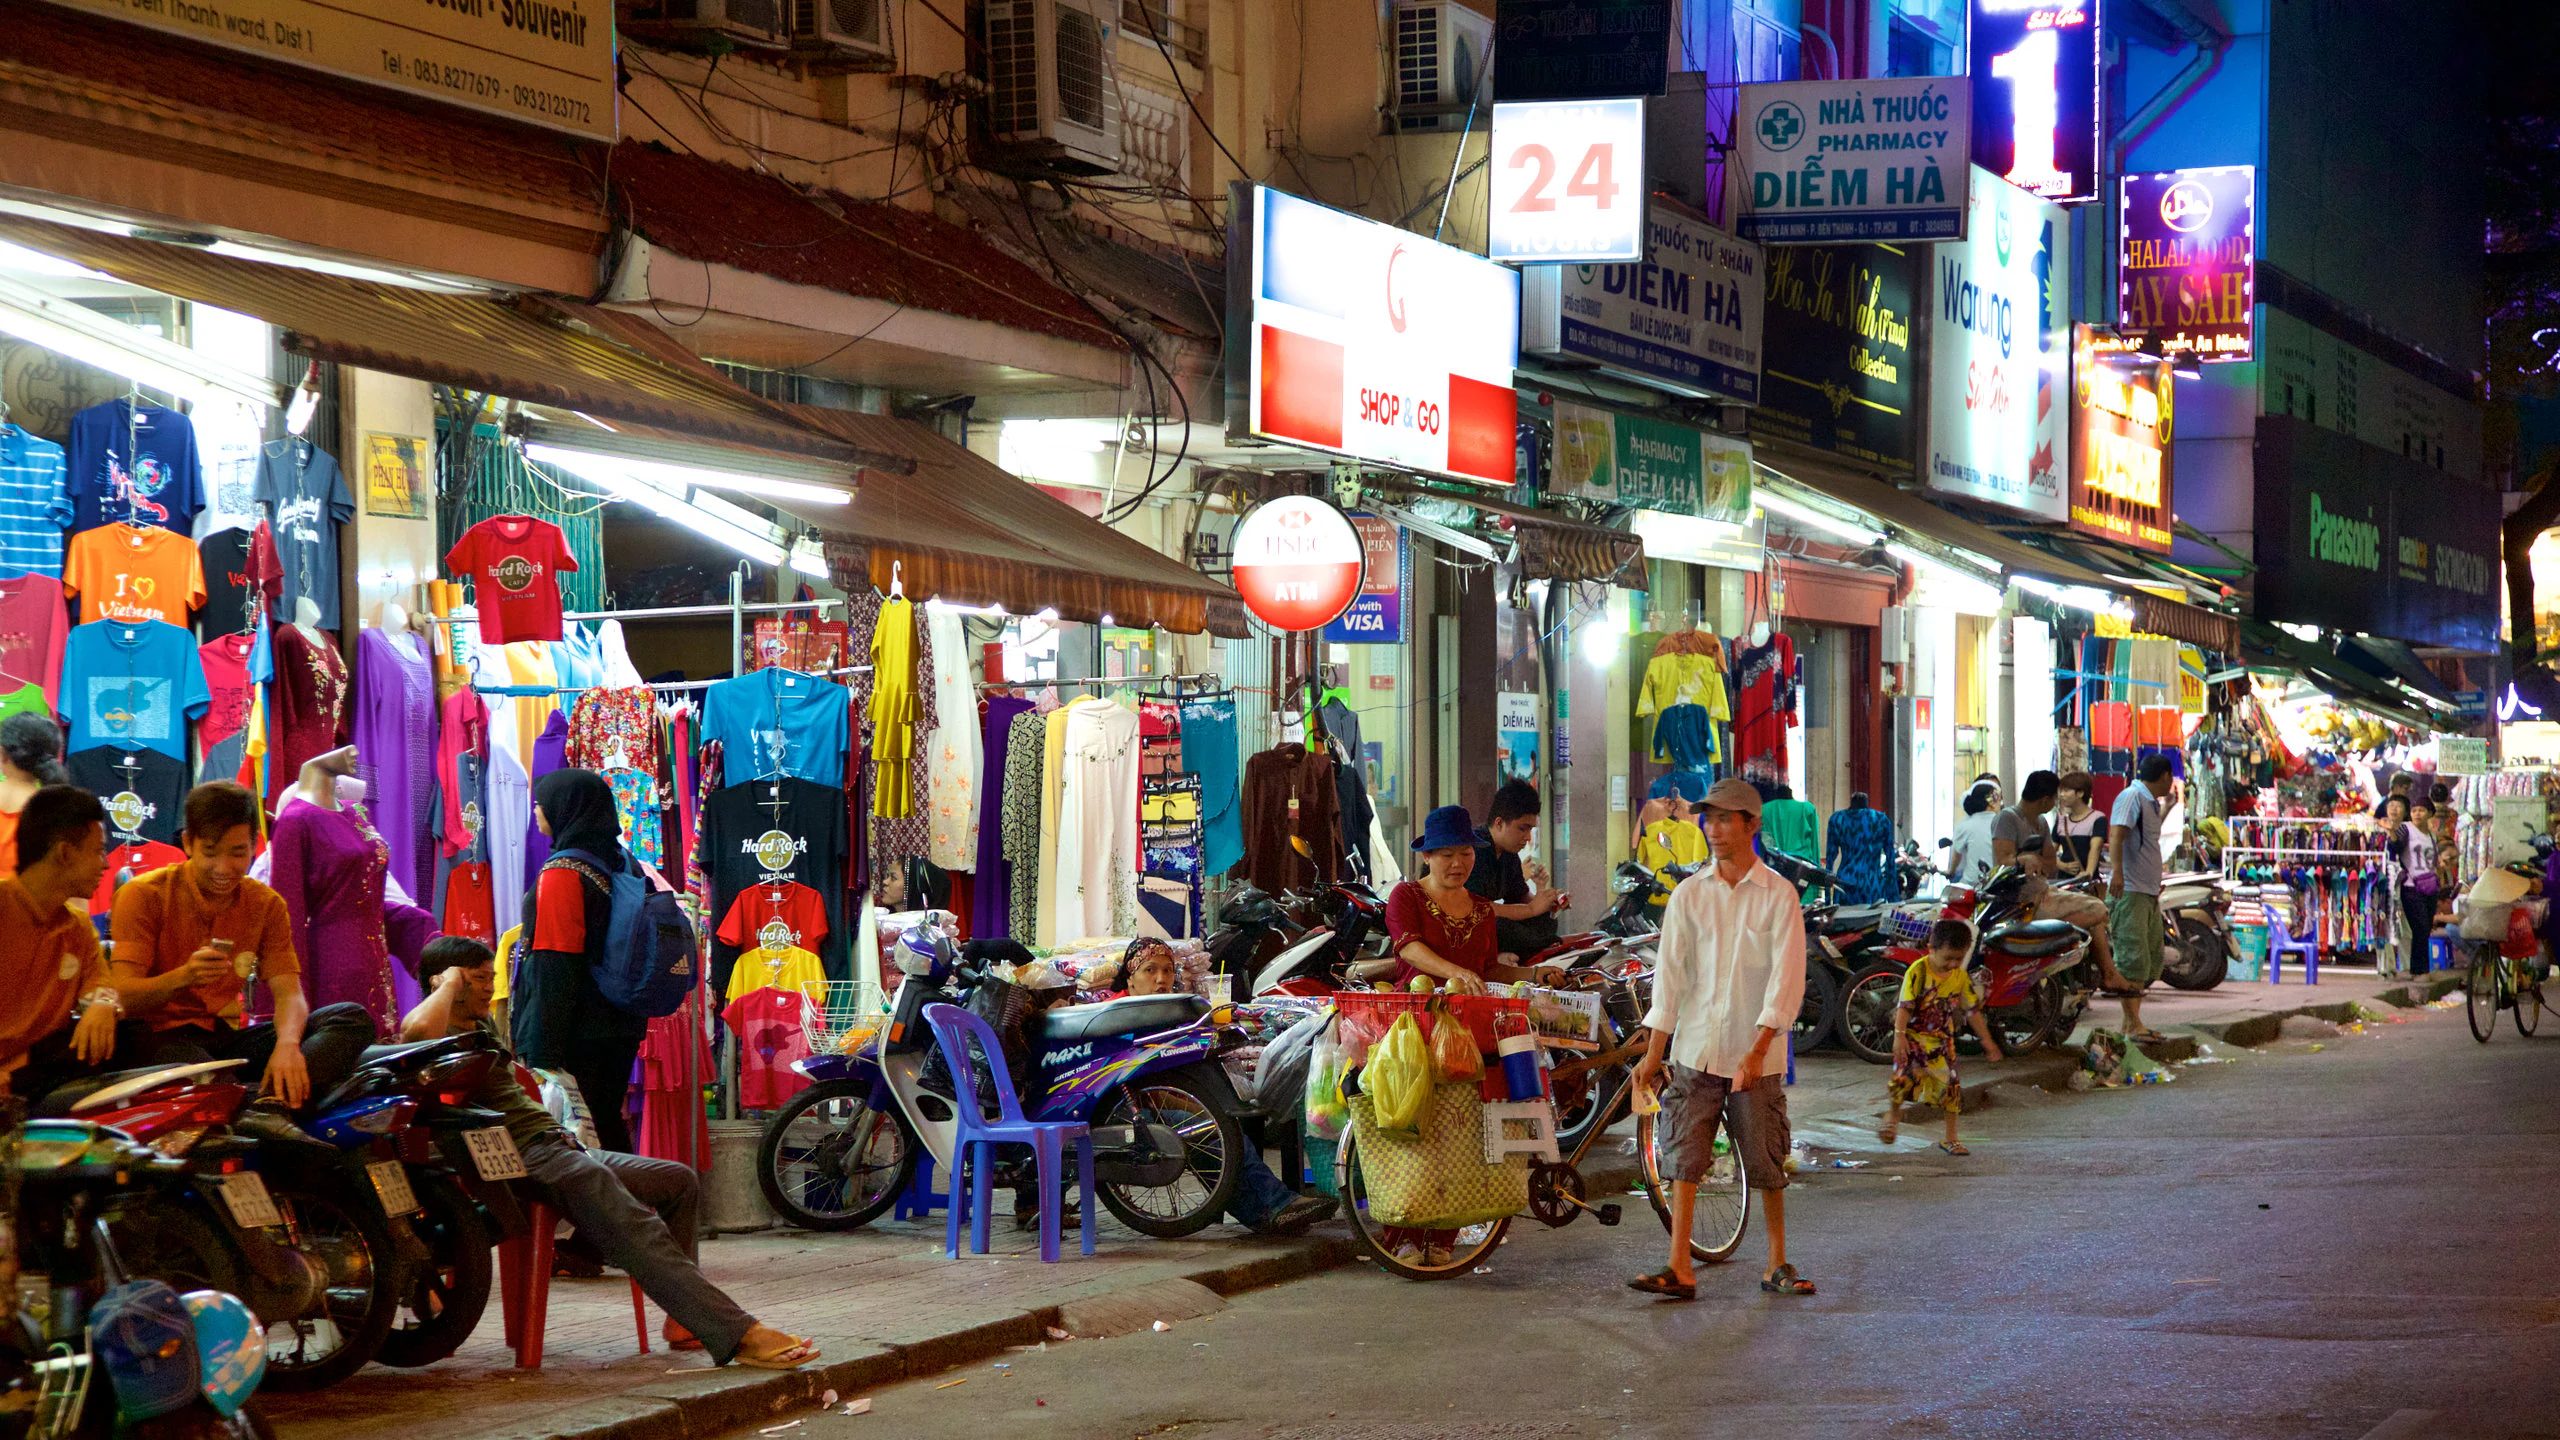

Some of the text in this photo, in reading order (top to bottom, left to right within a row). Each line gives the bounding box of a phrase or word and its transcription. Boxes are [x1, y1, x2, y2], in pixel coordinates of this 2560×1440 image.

[274, 22, 301, 49] Dist
[305, 29, 314, 52] 1
[501, 0, 587, 47] Souvenir
[381, 50, 402, 75] Tel
[413, 58, 500, 99] 083.8277679
[513, 84, 592, 124] 0932123772
[1819, 84, 1949, 127] NHÀ THUỐC
[1818, 130, 1949, 153] PHARMACY
[1507, 142, 1620, 214] 24
[1754, 154, 1868, 209] DIỄM
[1886, 156, 1945, 205] HÀ
[2128, 238, 2191, 269] HALAL
[1705, 275, 1743, 331] HÀ
[1942, 255, 2012, 360] Warung
[2178, 272, 2245, 326] SAH
[2195, 335, 2213, 352] An
[1849, 345, 1898, 385] Collection
[1360, 388, 1439, 435] SHOP & GO
[1630, 434, 1687, 464] PHARMACY
[1620, 459, 1665, 500] DIỄM
[2310, 492, 2380, 572] Panasonic
[515, 561, 543, 577] Rock
[115, 573, 128, 598] I
[1275, 580, 1319, 602] ATM
[98, 601, 166, 621] Vietnam
[1359, 601, 1382, 612] with
[1343, 614, 1384, 631] VISA
[1525, 713, 1535, 728] HÀ
[741, 836, 807, 854] Hard Rock
[758, 873, 795, 881] VIETNAM
[1041, 1046, 1083, 1068] MAX
[1160, 1041, 1202, 1058] Kawasaki
